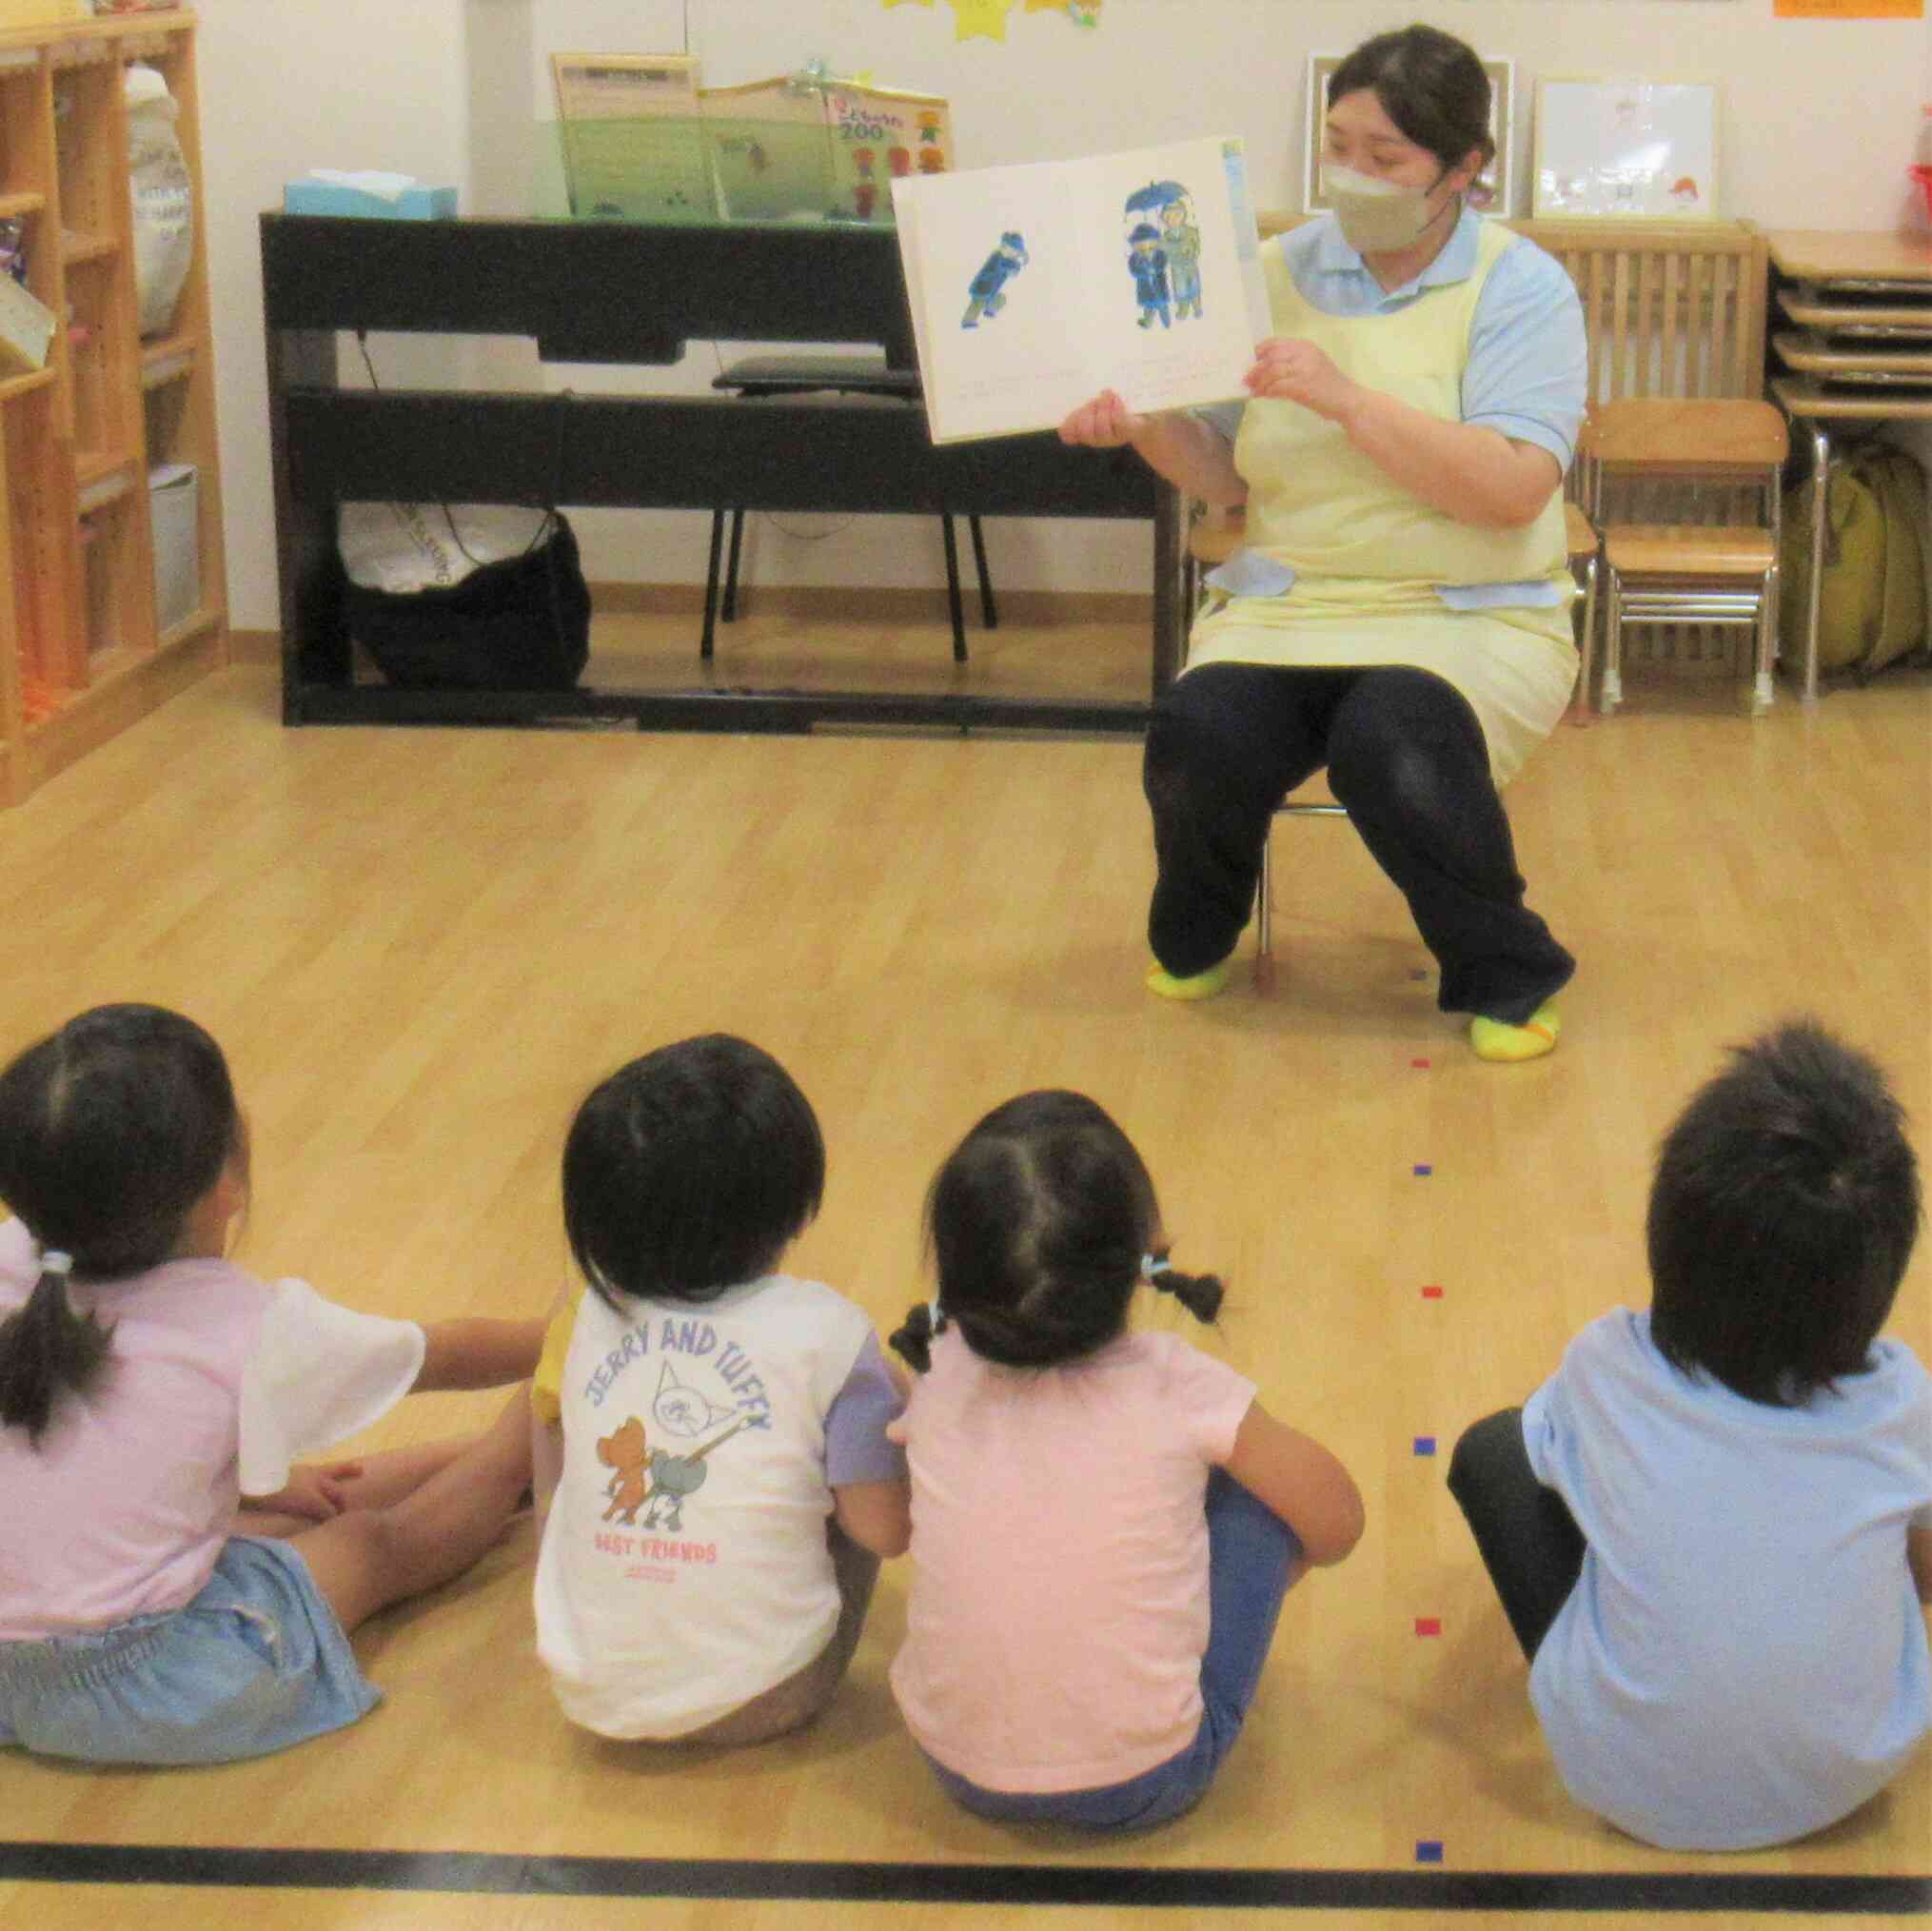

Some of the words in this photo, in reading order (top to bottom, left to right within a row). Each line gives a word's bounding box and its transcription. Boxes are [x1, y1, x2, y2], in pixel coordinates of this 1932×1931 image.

[840, 122, 884, 141] 200
[584, 1319, 648, 1408] JERRY
[660, 1318, 717, 1356] AND
[640, 1537, 718, 1565] FRIENDS
